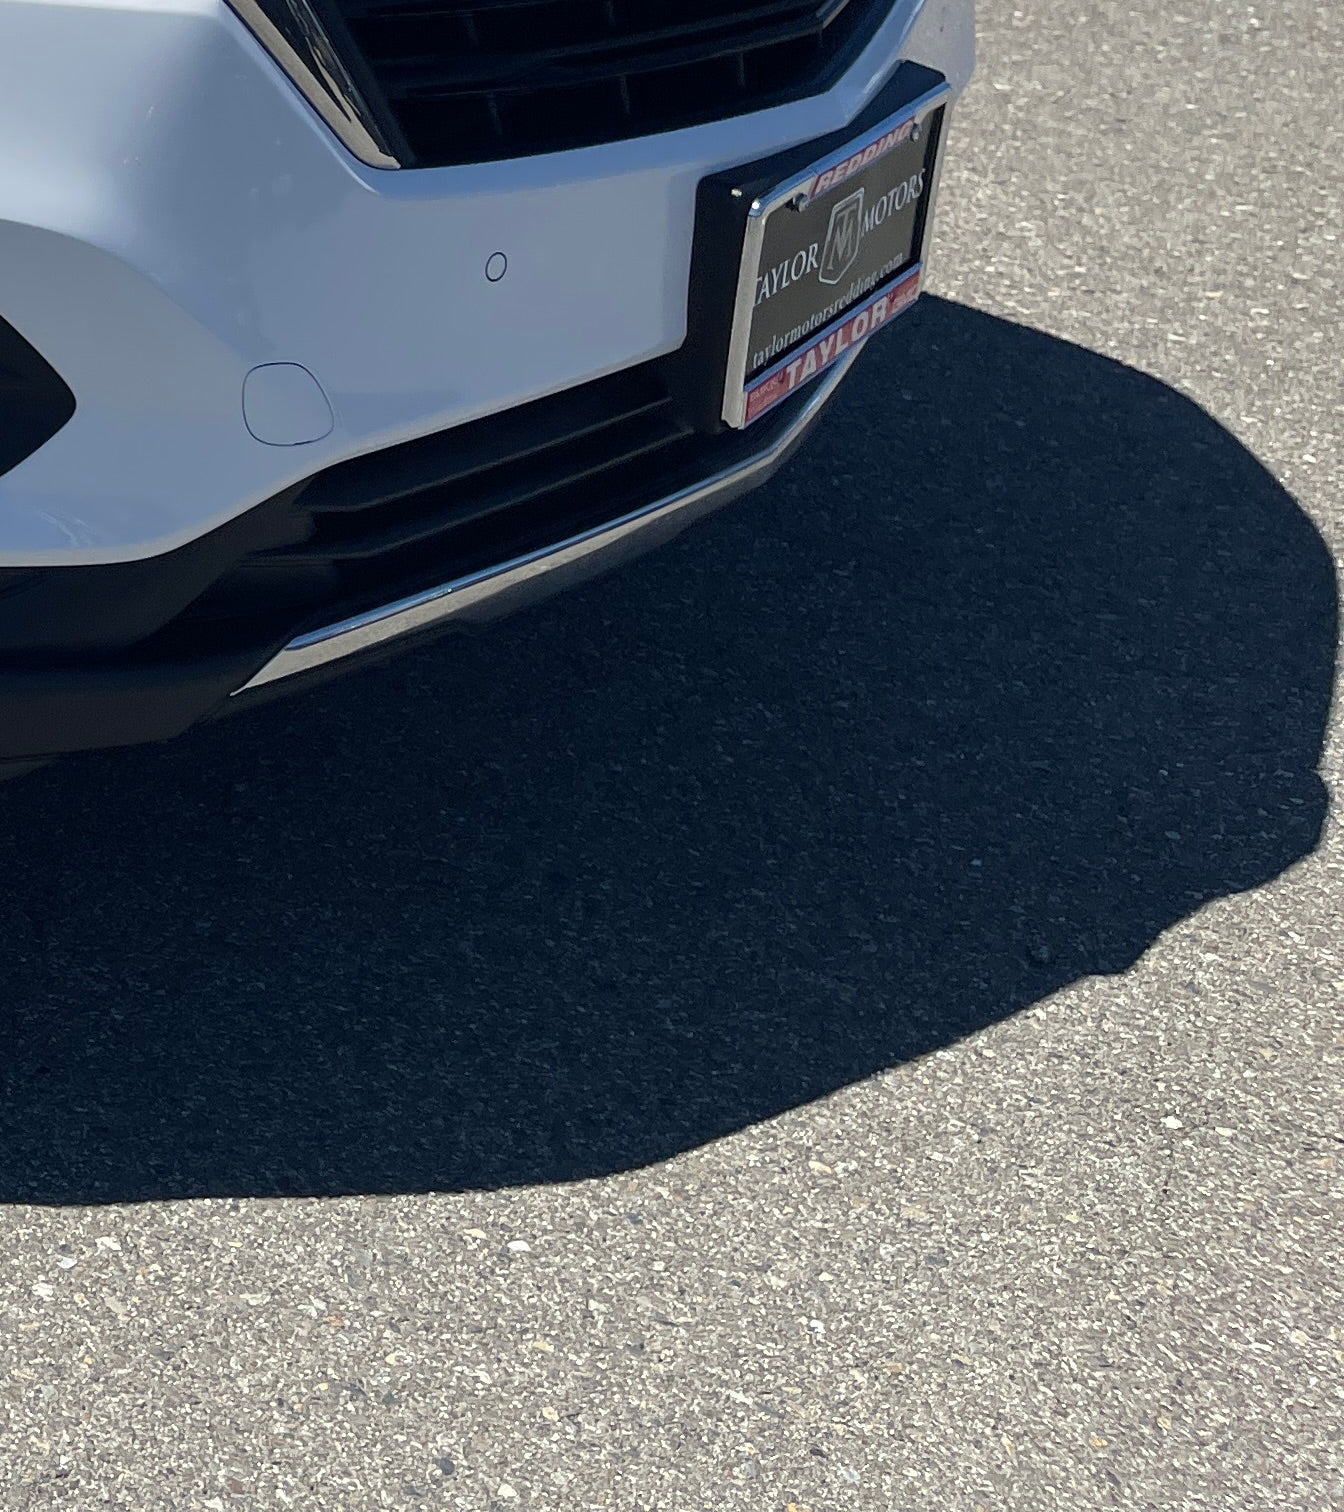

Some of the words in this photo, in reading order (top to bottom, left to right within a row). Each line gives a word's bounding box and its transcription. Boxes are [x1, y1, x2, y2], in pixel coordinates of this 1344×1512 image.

[814, 119, 913, 196] REDDING
[754, 242, 819, 307] TAYLOR
[862, 167, 926, 238] MOTORS
[752, 252, 905, 370] taylormotorsredding.com
